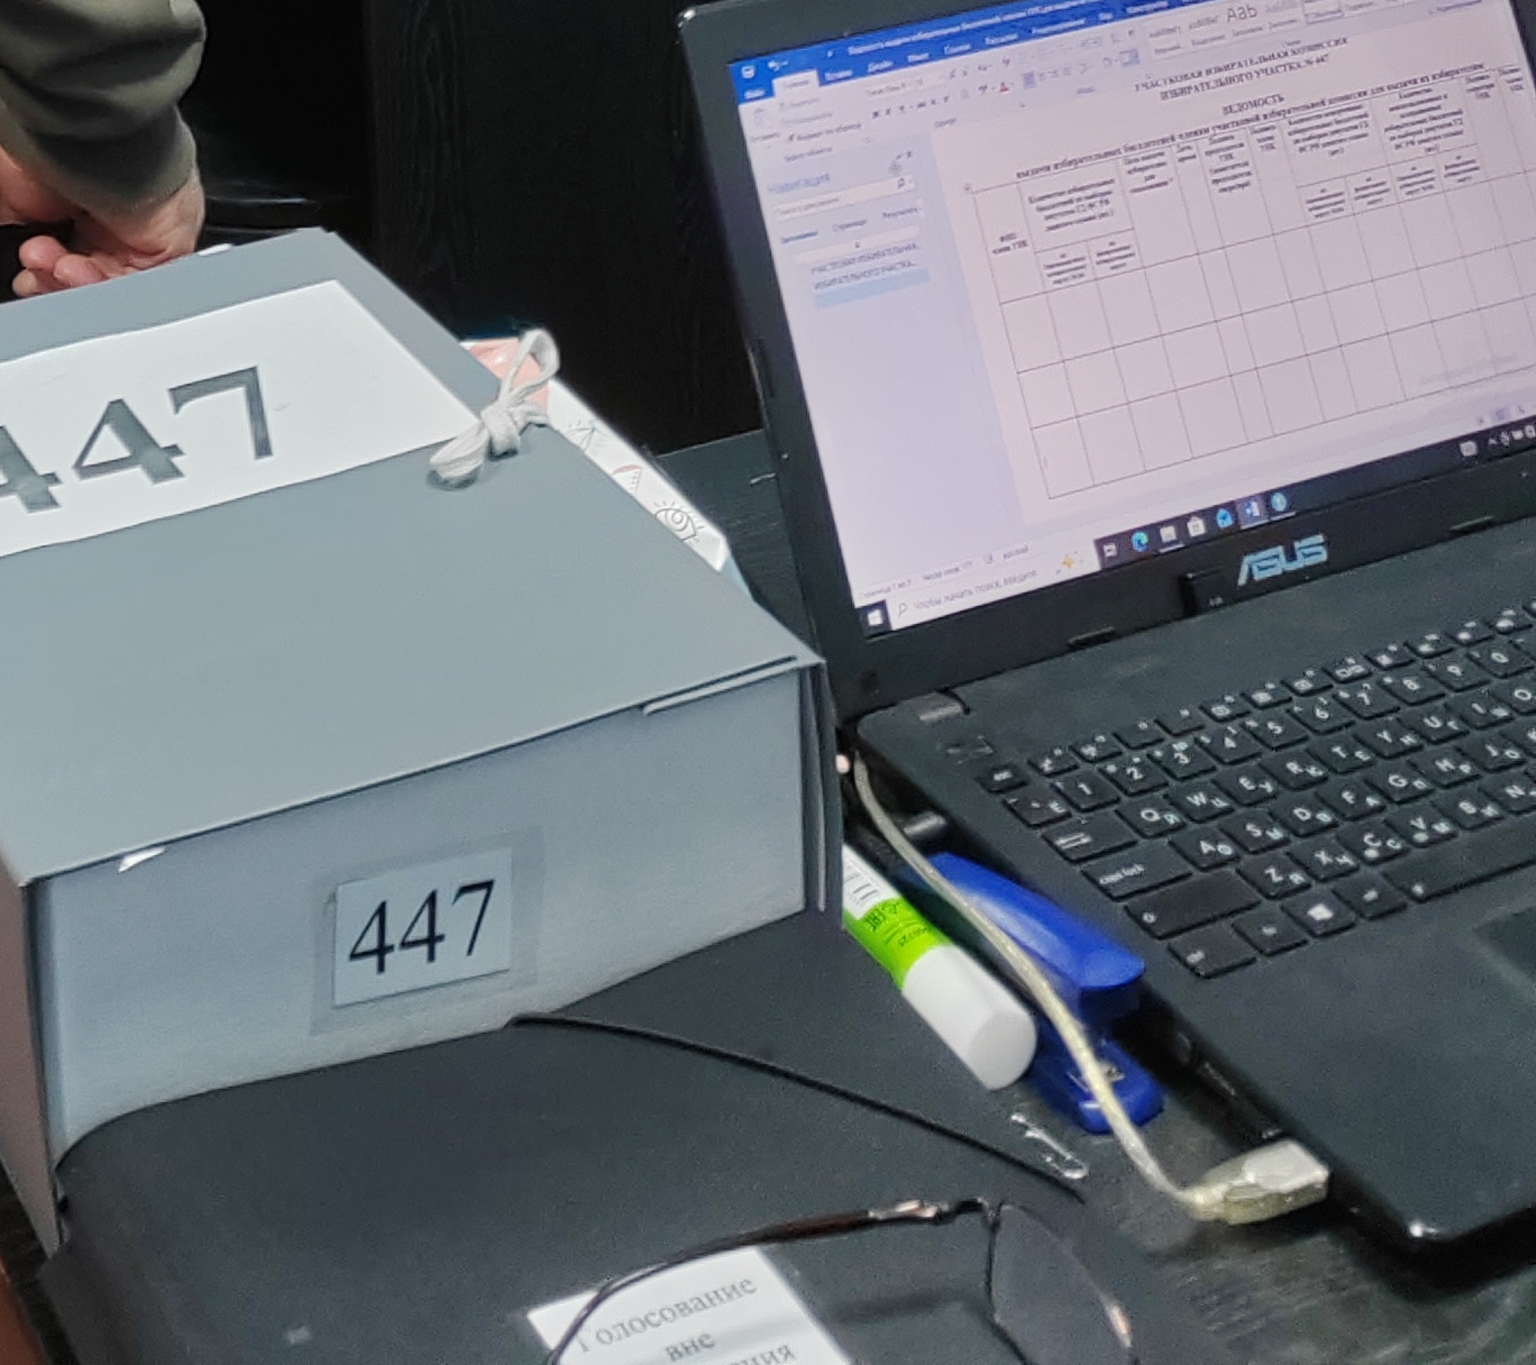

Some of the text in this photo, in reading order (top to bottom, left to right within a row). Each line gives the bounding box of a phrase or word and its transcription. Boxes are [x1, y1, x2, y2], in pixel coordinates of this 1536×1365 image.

[1237, 533, 1329, 587] ASUS
[349, 879, 495, 975] 447
[577, 1277, 757, 1353] Голосование
[665, 1332, 716, 1362] вне
